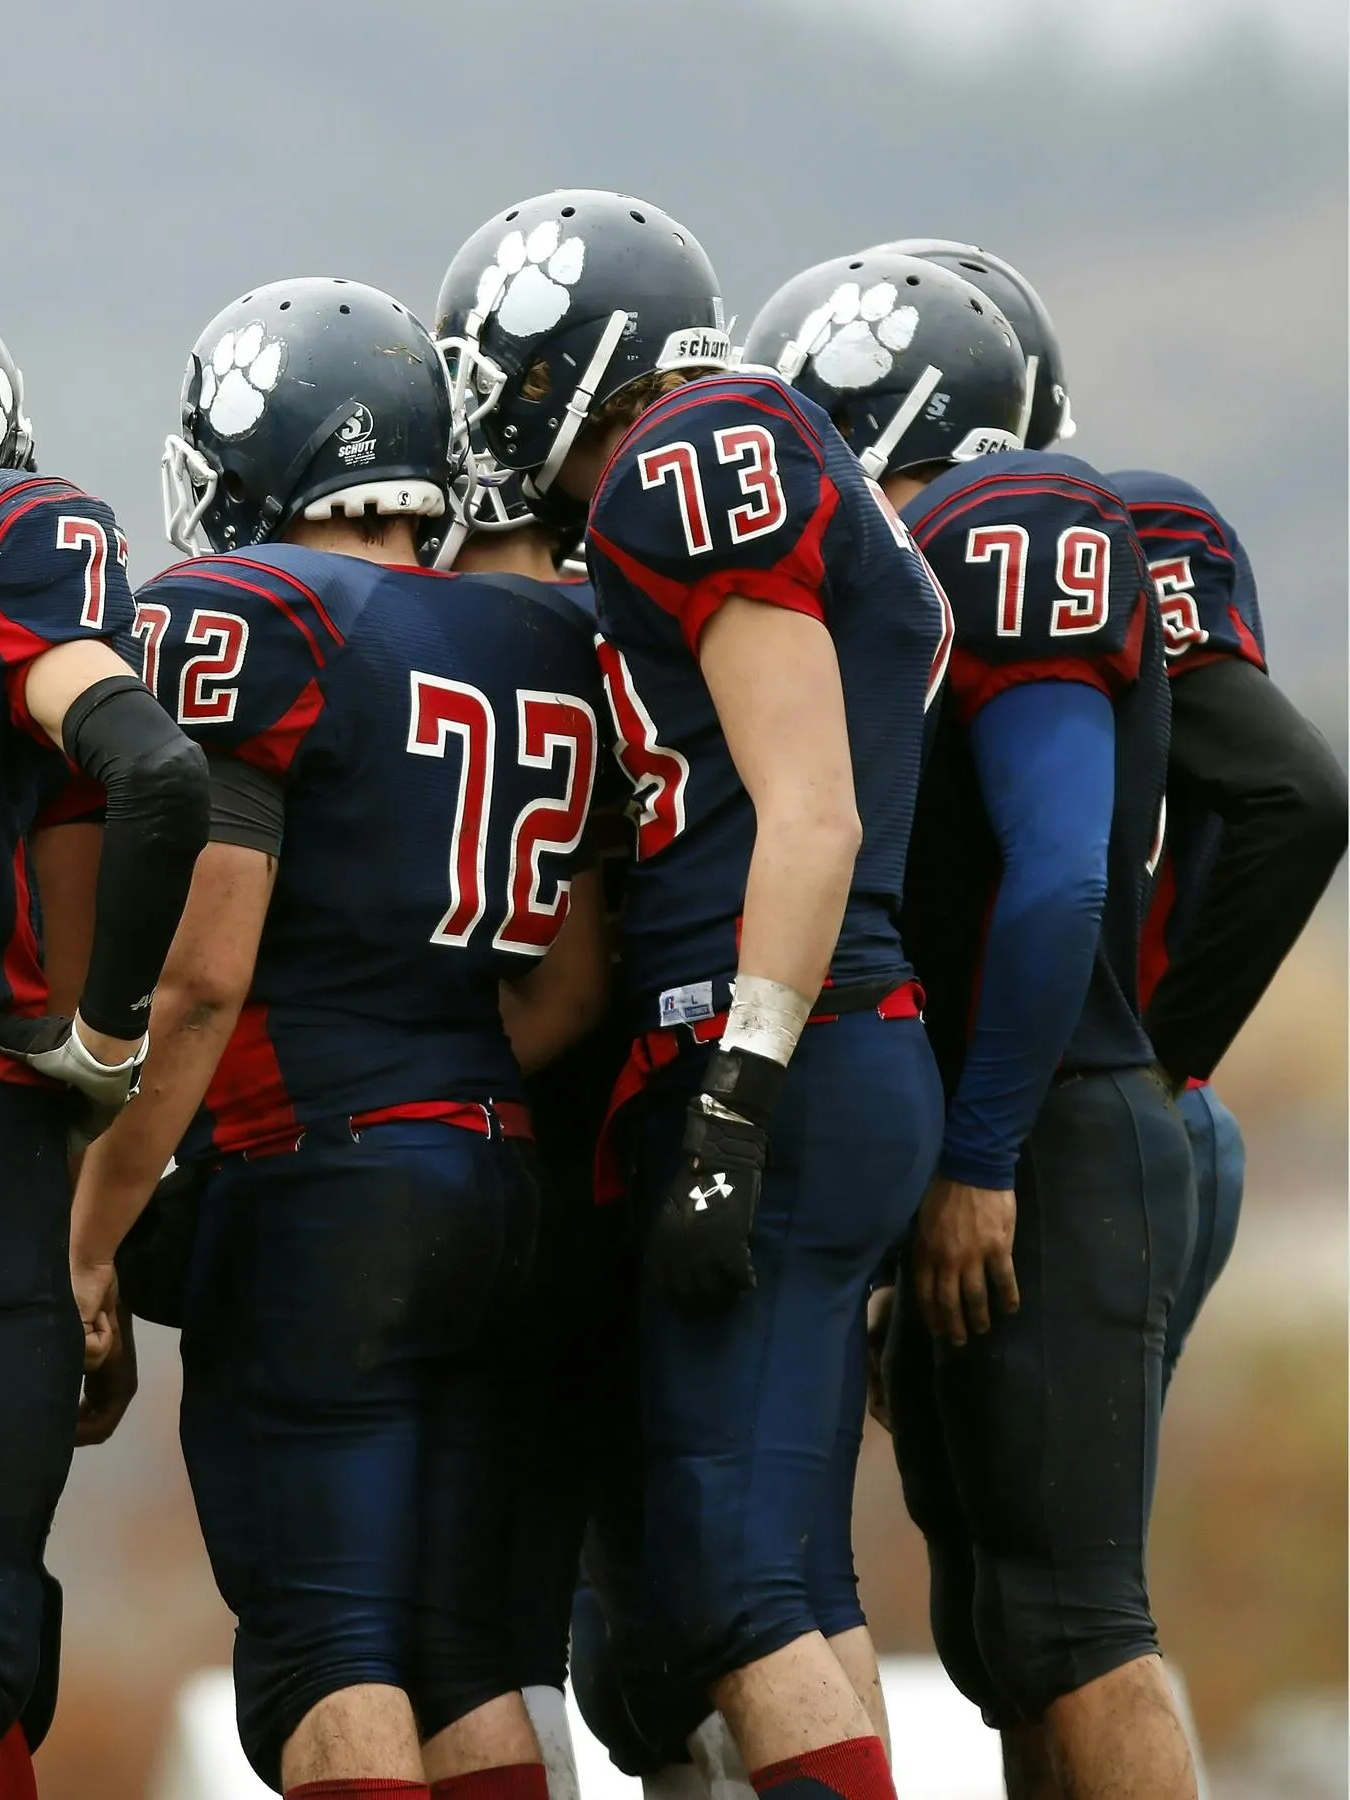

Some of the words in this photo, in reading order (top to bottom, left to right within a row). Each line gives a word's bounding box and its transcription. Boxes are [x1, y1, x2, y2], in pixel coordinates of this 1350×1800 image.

[337, 438, 378, 458] SCHUTT
[637, 424, 788, 556] 73
[965, 524, 1111, 637] 79
[131, 602, 250, 725] 72
[406, 670, 599, 957] 72
